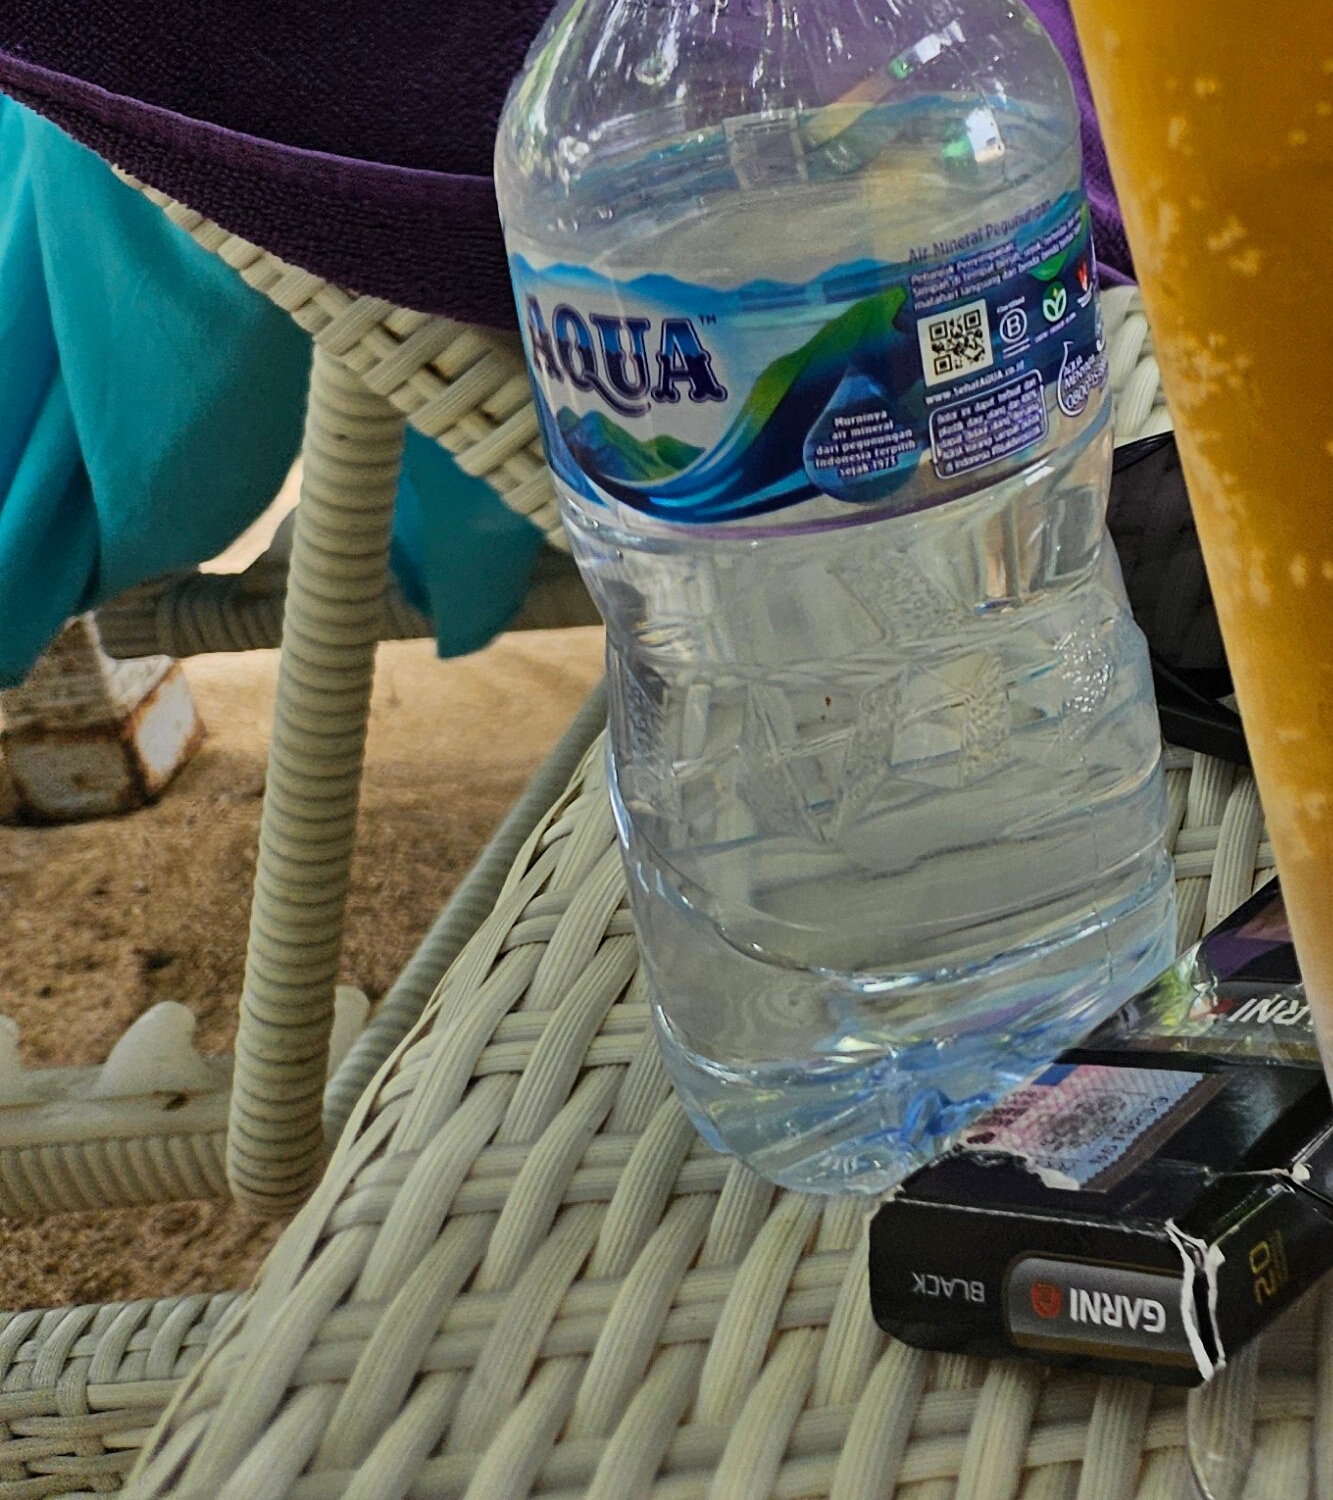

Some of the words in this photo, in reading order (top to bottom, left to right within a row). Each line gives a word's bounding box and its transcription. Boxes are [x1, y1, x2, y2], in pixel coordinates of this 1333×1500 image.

[932, 227, 983, 257] Mineral
[526, 293, 728, 418] AQUA
[850, 420, 894, 438] mineral
[1227, 994, 1310, 1026] RNI
[911, 1271, 985, 1303] BLACK
[1070, 1286, 1165, 1334] GARNI
